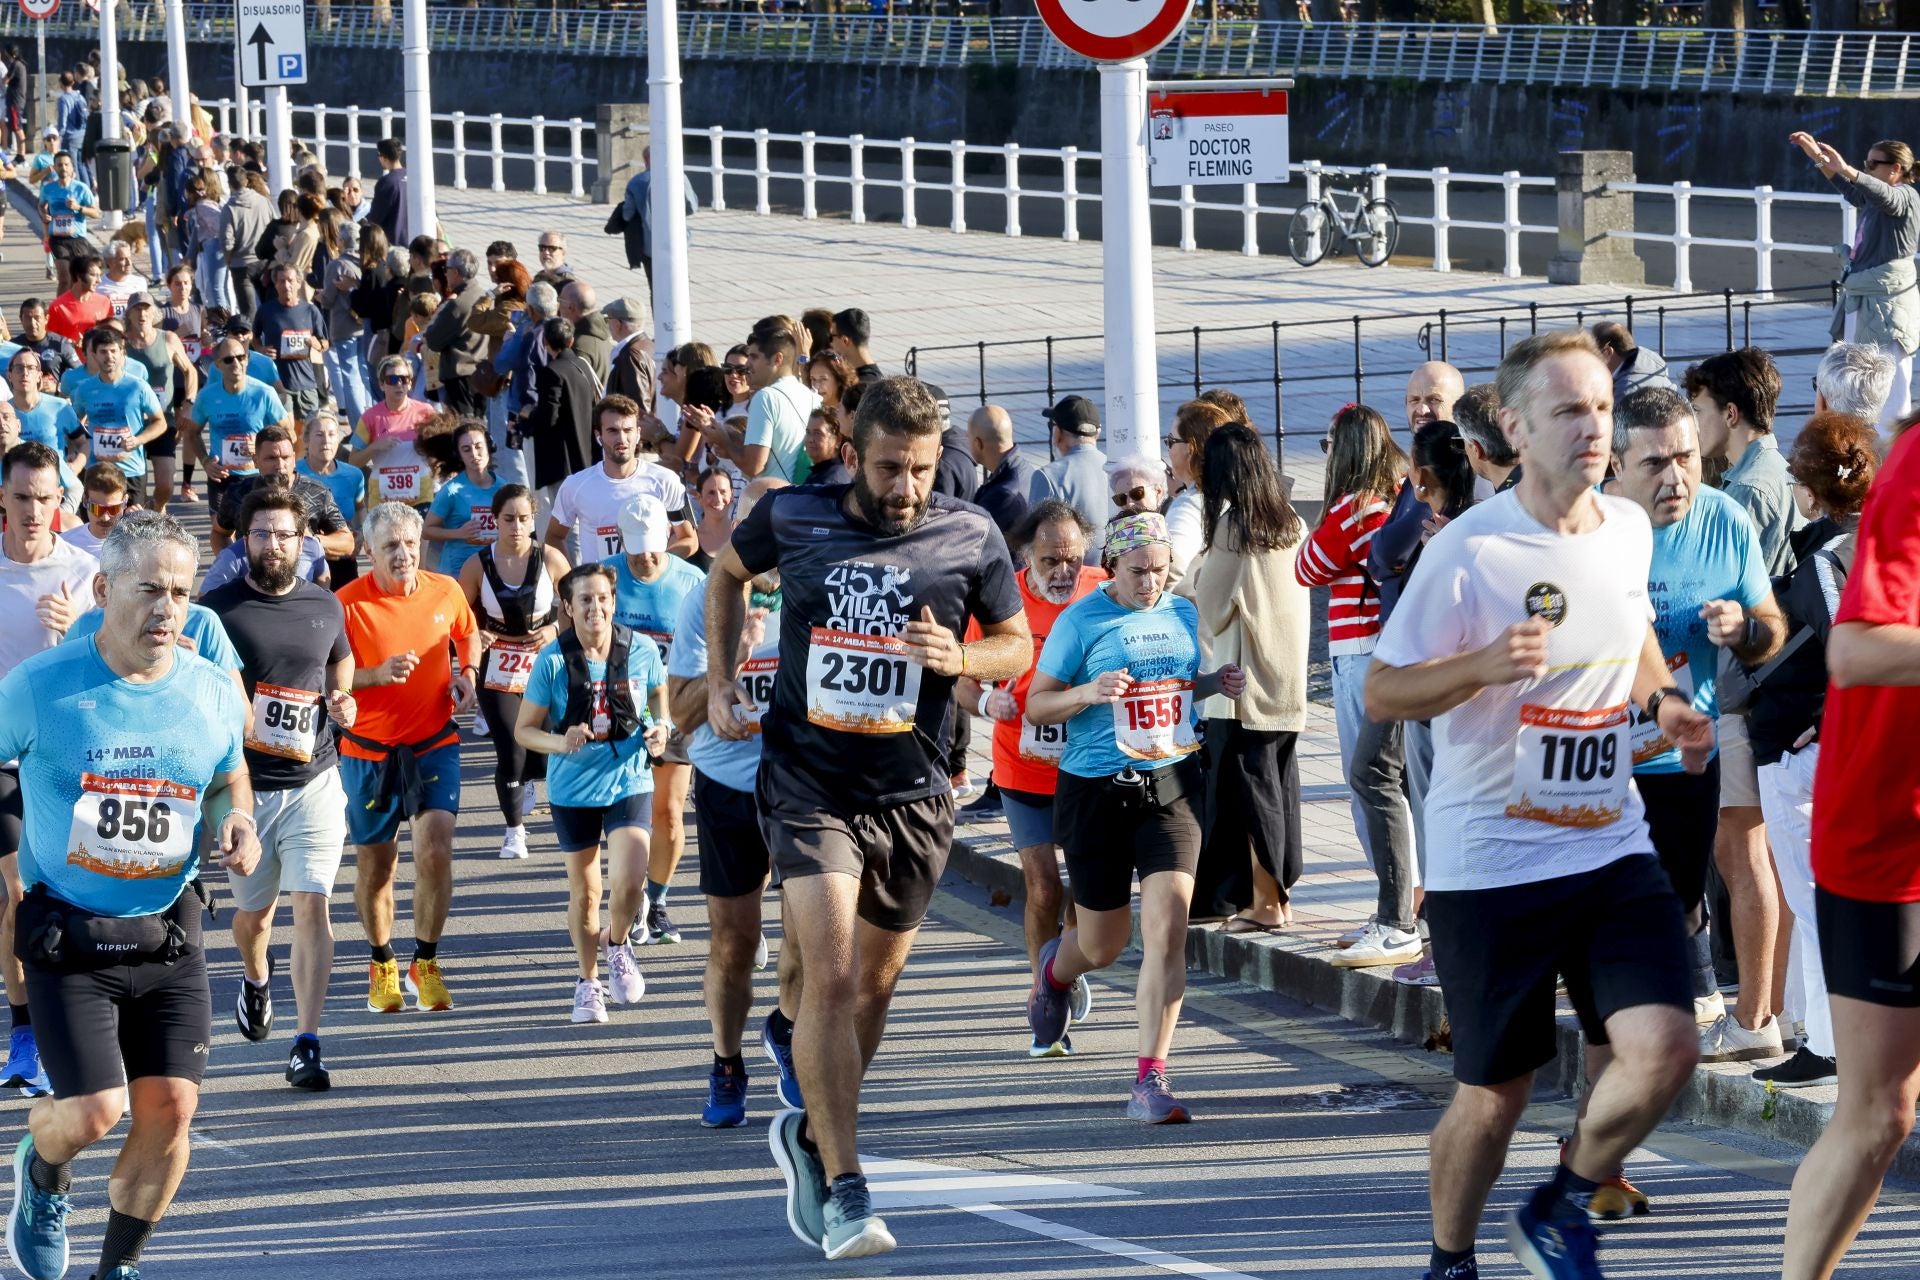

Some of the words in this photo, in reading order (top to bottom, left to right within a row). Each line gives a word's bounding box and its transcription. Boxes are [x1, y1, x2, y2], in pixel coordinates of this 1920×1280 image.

[243, 4, 301, 16] DISUASORIO
[282, 57, 298, 77] P
[1204, 123, 1234, 133] PASEO
[1189, 139, 1251, 156] DOCTOR
[1188, 159, 1252, 177] FLEMING
[99, 435, 124, 449] 442
[387, 474, 413, 490] 398
[825, 567, 874, 598] 45
[828, 593, 891, 622] VILLA
[893, 613, 910, 625] DE
[844, 638, 866, 647] MBA
[1142, 633, 1169, 643] MBA
[499, 652, 533, 673] 224
[820, 652, 907, 697] 2301
[264, 700, 312, 734] 958
[1124, 694, 1182, 731] 1558
[113, 746, 155, 760] MBA
[1541, 732, 1617, 782] 1109
[104, 764, 156, 778] media
[113, 782, 137, 791] MBA
[97, 798, 171, 843] 856
[96, 943, 138, 951] KIPRUN
